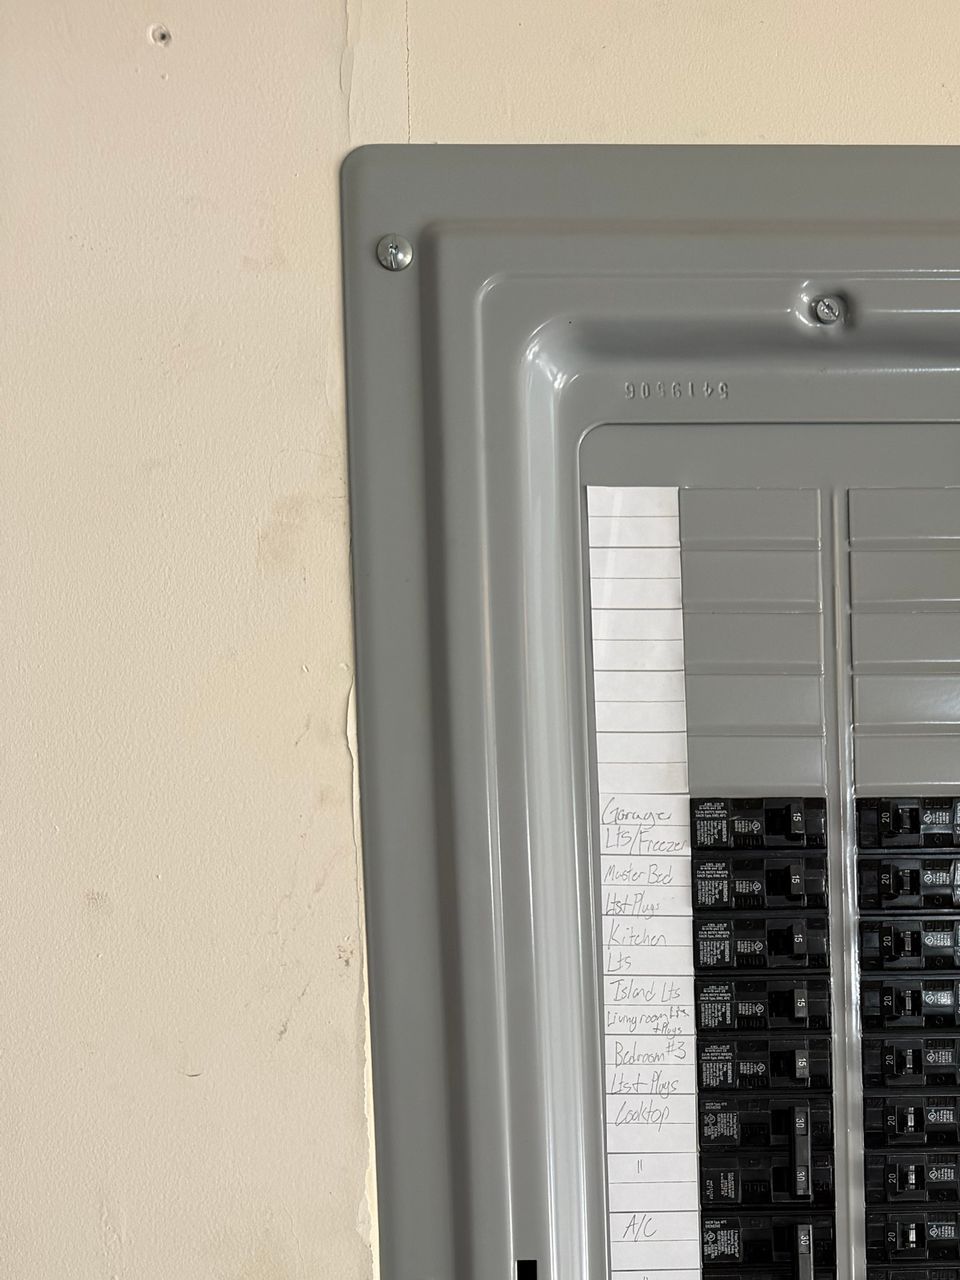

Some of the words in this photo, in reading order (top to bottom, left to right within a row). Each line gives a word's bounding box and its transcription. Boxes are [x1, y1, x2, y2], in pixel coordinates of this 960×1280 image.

[601, 796, 672, 829] Garage
[793, 812, 801, 822] 15
[881, 812, 890, 823] 20
[604, 862, 646, 883] Master
[648, 863, 673, 885] Bed
[881, 873, 890, 884] 20
[792, 875, 800, 884] 15
[607, 918, 667, 949] Kitchen
[794, 934, 803, 943] 15
[883, 936, 892, 946] 20
[607, 951, 632, 973] Lts
[610, 978, 656, 1001] Island
[661, 981, 681, 1003] Lts
[797, 998, 806, 1007] 15
[884, 996, 893, 1007] 20
[615, 1041, 665, 1068] Bedroom
[885, 1055, 894, 1065] 20
[798, 1058, 807, 1067] 15
[614, 1099, 670, 1133] Cooktop
[887, 1115, 896, 1126] 20
[795, 1118, 805, 1128] 30
[796, 1171, 806, 1182] 30
[888, 1173, 897, 1184] 20
[622, 1213, 656, 1242] A/C
[801, 1234, 810, 1246] 30
[888, 1232, 896, 1242] 20
